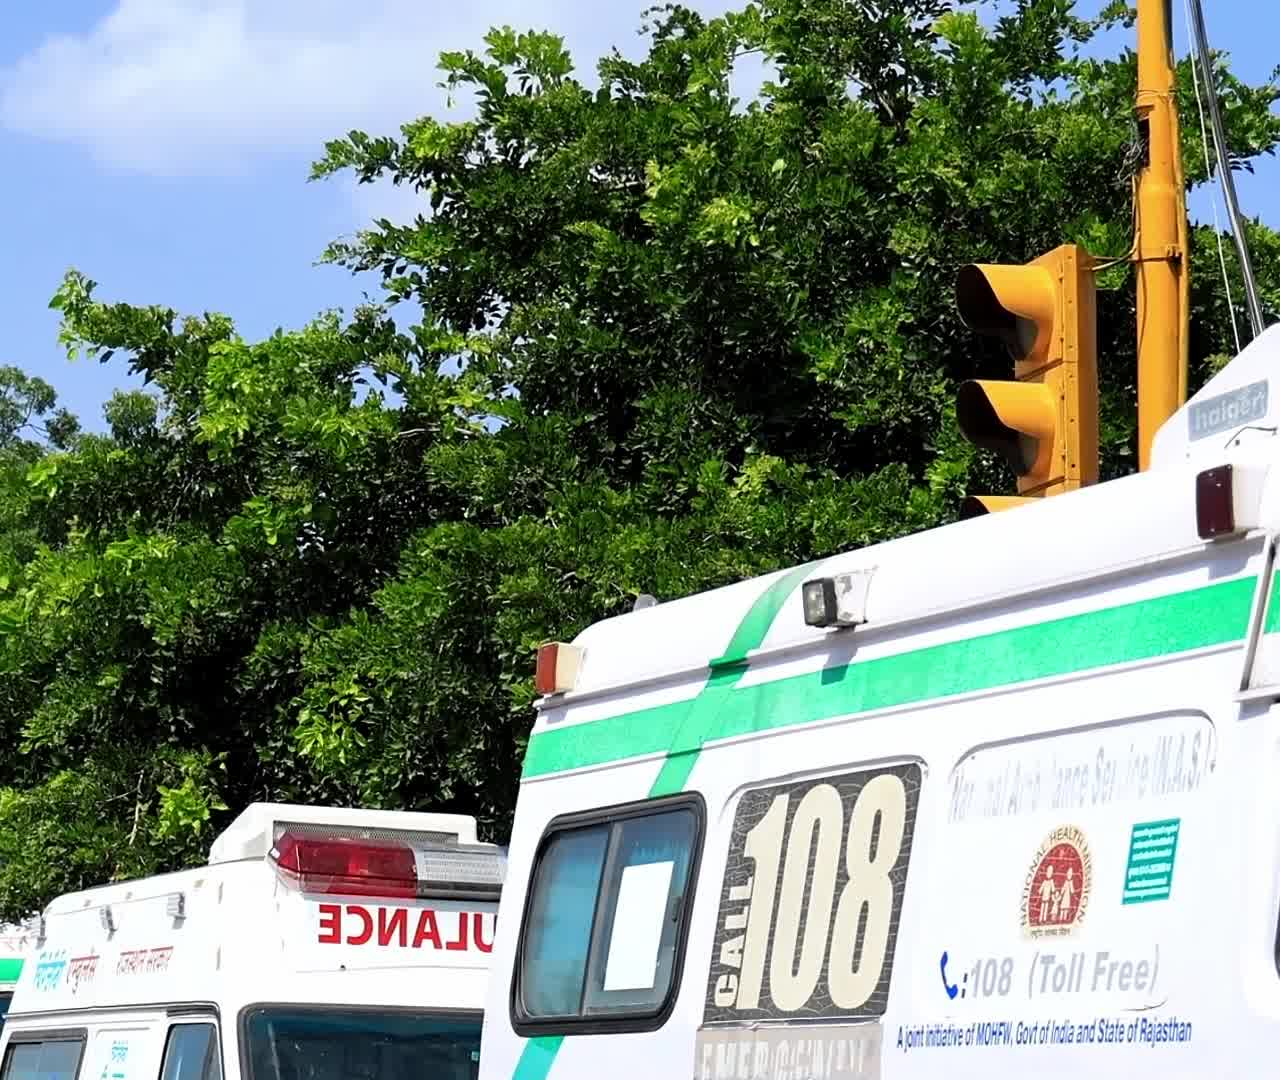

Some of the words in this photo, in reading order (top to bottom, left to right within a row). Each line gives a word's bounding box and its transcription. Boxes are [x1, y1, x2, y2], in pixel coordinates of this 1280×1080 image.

[735, 773, 907, 1012] 108
[714, 876, 756, 1008] CALL
[1029, 950, 1085, 1000] (Toll
[1091, 944, 1160, 996] Free)
[896, 1026, 904, 1048] A
[904, 1024, 924, 1052] joint
[925, 1023, 964, 1047] initiative
[965, 1022, 977, 1046] of
[1015, 1021, 1039, 1045] Govt
[1039, 1020, 1052, 1044] of
[1051, 1019, 1076, 1044] India
[1076, 1018, 1096, 1043] and
[1097, 1018, 1126, 1043] State
[1127, 1017, 1141, 1042] of
[1140, 1017, 1193, 1048] Rajasthan
